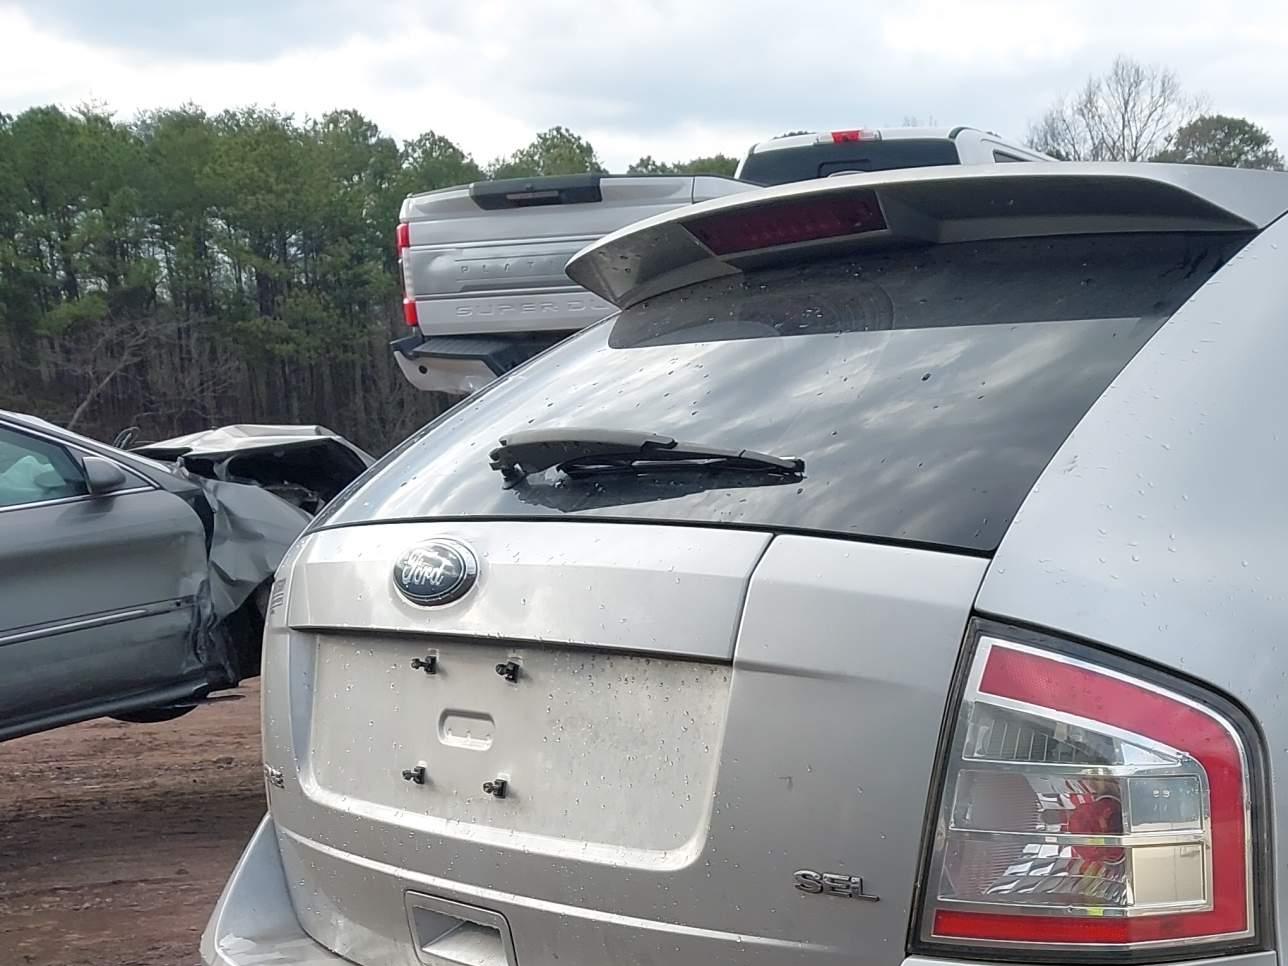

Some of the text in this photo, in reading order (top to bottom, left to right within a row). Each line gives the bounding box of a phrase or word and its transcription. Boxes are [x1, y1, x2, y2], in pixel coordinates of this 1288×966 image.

[455, 302, 560, 317] SUPER
[401, 549, 447, 585] Ford
[793, 868, 881, 902] SEL
